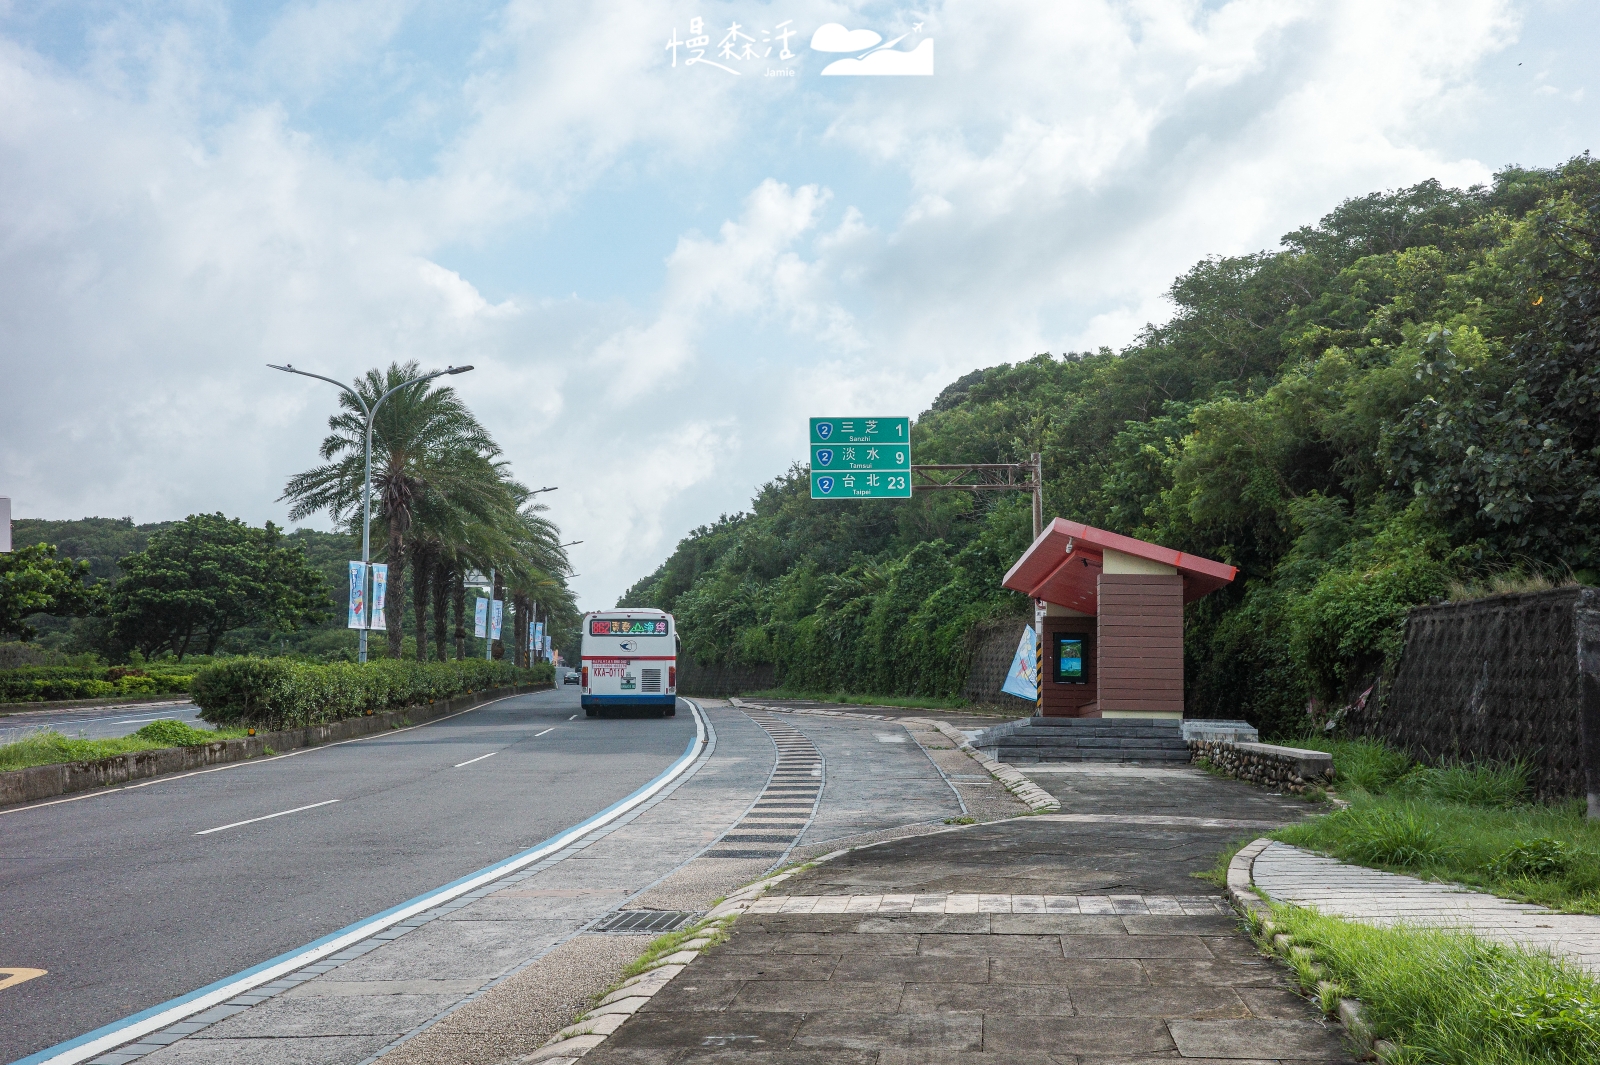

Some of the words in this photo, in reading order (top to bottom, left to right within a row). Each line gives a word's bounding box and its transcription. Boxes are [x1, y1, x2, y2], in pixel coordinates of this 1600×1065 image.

[821, 426, 829, 435] 2
[841, 420, 878, 433] 三芝
[896, 424, 902, 436] 1
[821, 452, 829, 461] 2
[842, 447, 880, 461] 淡水
[895, 452, 905, 465] 9
[822, 480, 830, 489] 2
[842, 474, 880, 488] 台北
[887, 477, 906, 490] 23
[593, 668, 625, 677] KKA-0110
